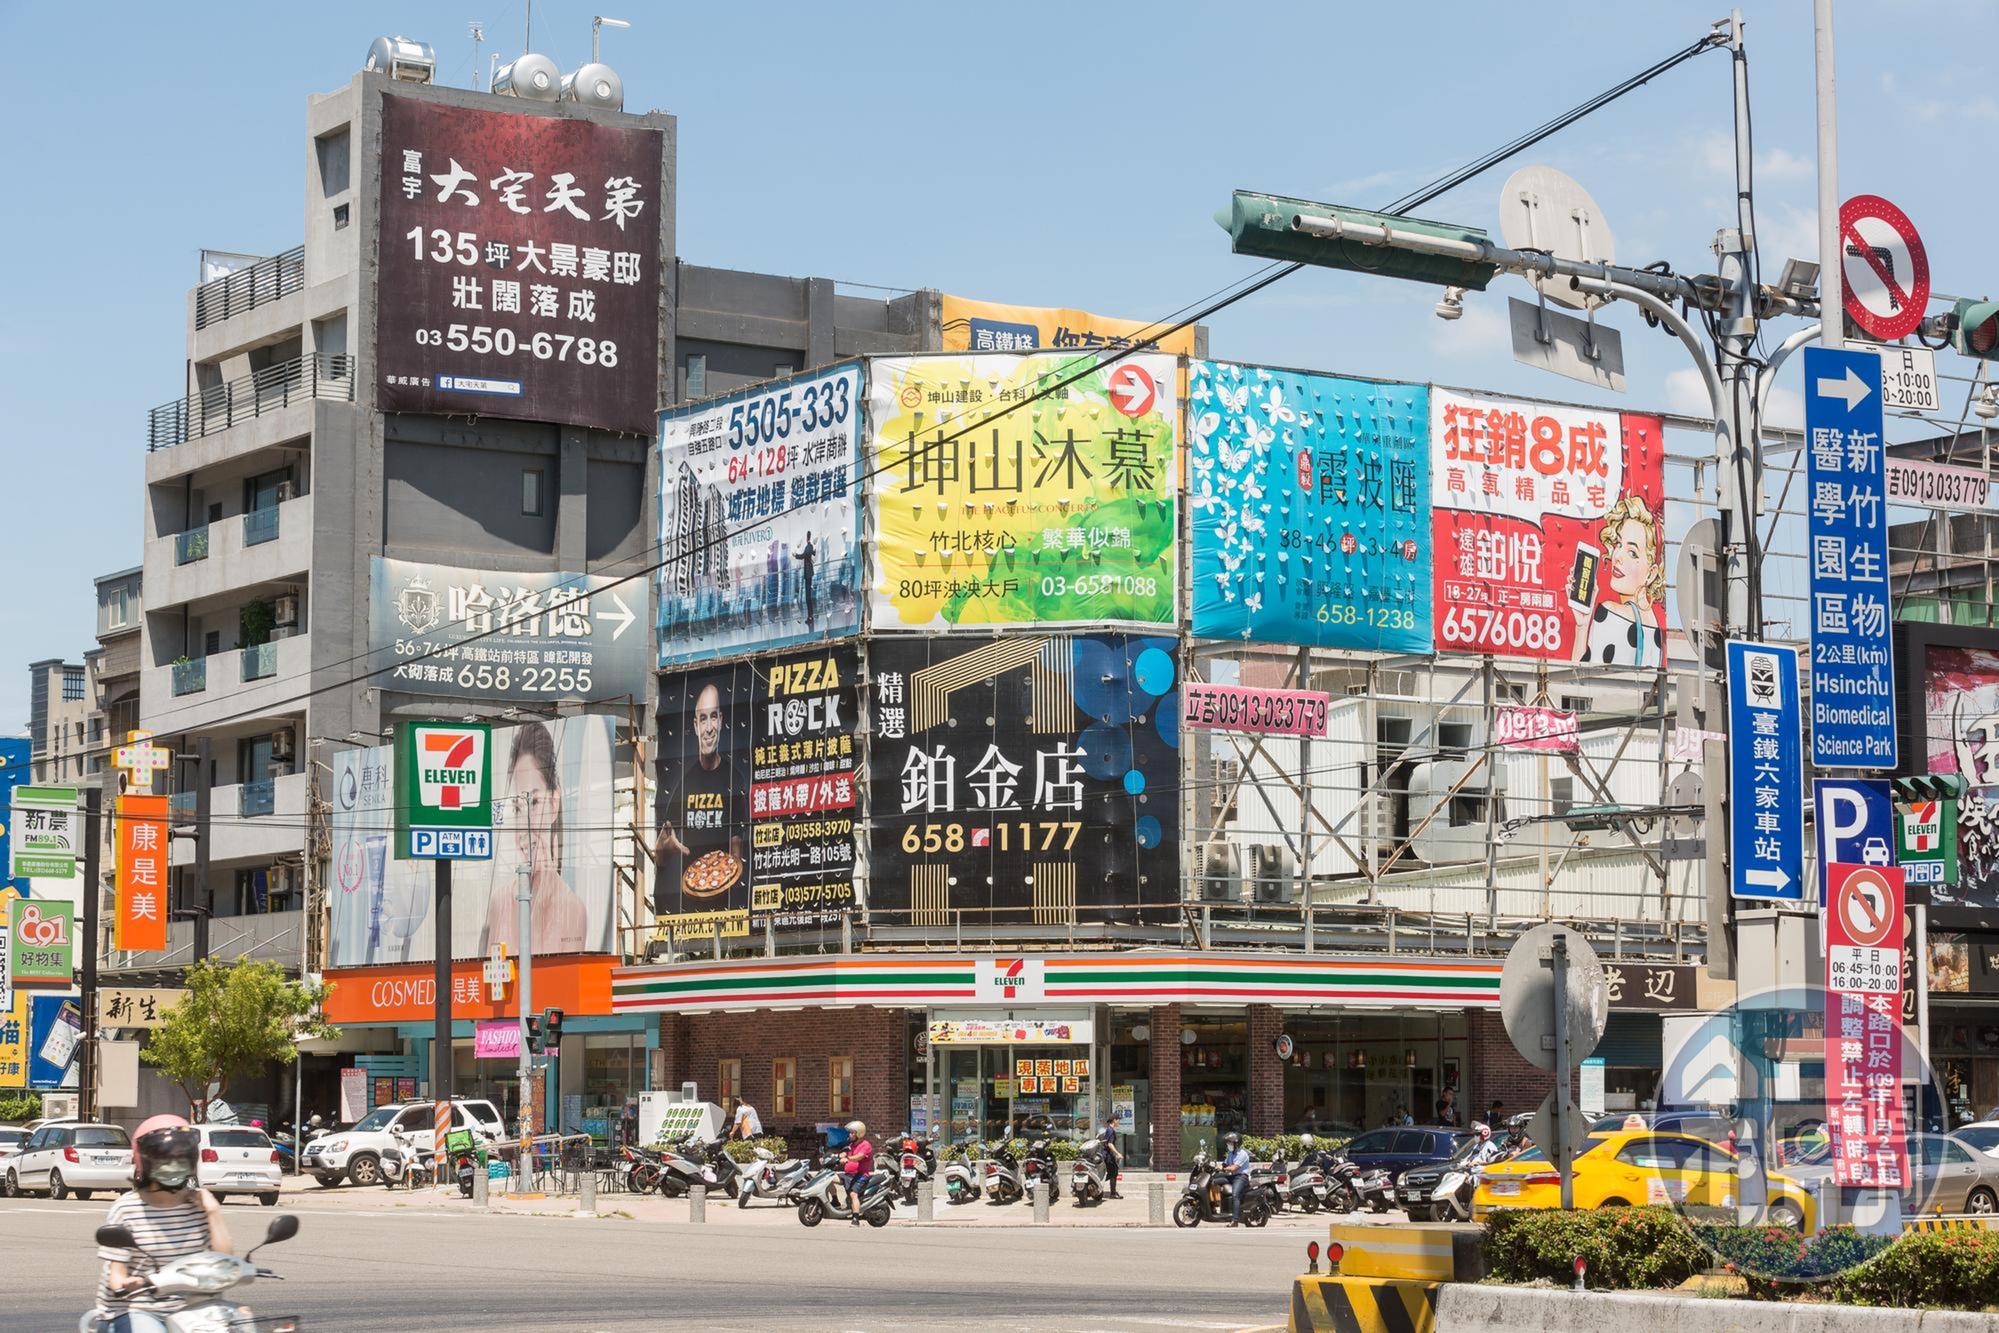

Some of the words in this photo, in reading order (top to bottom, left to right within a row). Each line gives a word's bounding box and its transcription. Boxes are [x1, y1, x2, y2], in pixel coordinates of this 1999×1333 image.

[402, 149, 423, 200] 富宇
[430, 157, 645, 232] 大宅天第
[452, 276, 597, 323] 壯闊落成
[415, 328, 442, 347] 03
[446, 324, 618, 368] 550-6788
[927, 388, 983, 404] 坤山建設
[728, 376, 849, 450] 5505-333
[1443, 402, 1610, 479] 狂銷8成
[1317, 449, 1417, 514] 霞波匯
[727, 480, 786, 521] 城市地標
[929, 530, 1018, 552] 竹北核心
[1041, 527, 1132, 551] 繁華似錦
[1811, 427, 1849, 635] 醫學園區
[1847, 428, 1886, 638] 新竹生物
[899, 578, 1019, 600] 80坪泱泱大戶
[1041, 575, 1157, 598] 03-6581088
[1316, 604, 1415, 630] 658-1238
[1442, 606, 1562, 651] 6576088
[461, 646, 540, 665] 高鐵站前特區
[1816, 643, 1888, 666] 2公里(km)
[393, 662, 454, 684] 大砌落成
[768, 658, 840, 697] PIZZA
[1815, 672, 1889, 696] Hsinchu
[877, 671, 906, 740] 精選
[1815, 703, 1890, 727] Biomedical
[1817, 734, 1863, 756] Science
[1865, 735, 1892, 756] Park
[424, 768, 477, 785] ELEVEN
[900, 741, 1088, 814] 鉑金店
[1751, 711, 1782, 862] 臺鐵六家車站
[687, 793, 724, 809] PIZZA
[753, 778, 850, 813] 披薩外帶/外送
[25, 810, 69, 832] 新農
[755, 827, 780, 844] 竹北店
[785, 820, 851, 842] (03)558-3970
[1821, 787, 1868, 864] P
[1907, 823, 1938, 836] ELEVEN
[416, 832, 432, 853] P
[441, 832, 462, 841] ATM
[901, 823, 965, 854] 658
[996, 821, 1083, 851] 1177
[753, 842, 852, 871] 竹北市光明一路105號
[131, 823, 159, 922] 康是美
[1932, 865, 1942, 880] P
[754, 887, 779, 906] 新竹店
[785, 883, 852, 906] (03)577-5705
[21, 951, 63, 967] 好物集
[1851, 947, 1881, 963] 平日
[994, 977, 1025, 986] ELEVEN
[1832, 962, 1898, 977] 06:45~10:00
[371, 978, 436, 1008] COSMED
[1832, 976, 1898, 991] 16:00~20:00
